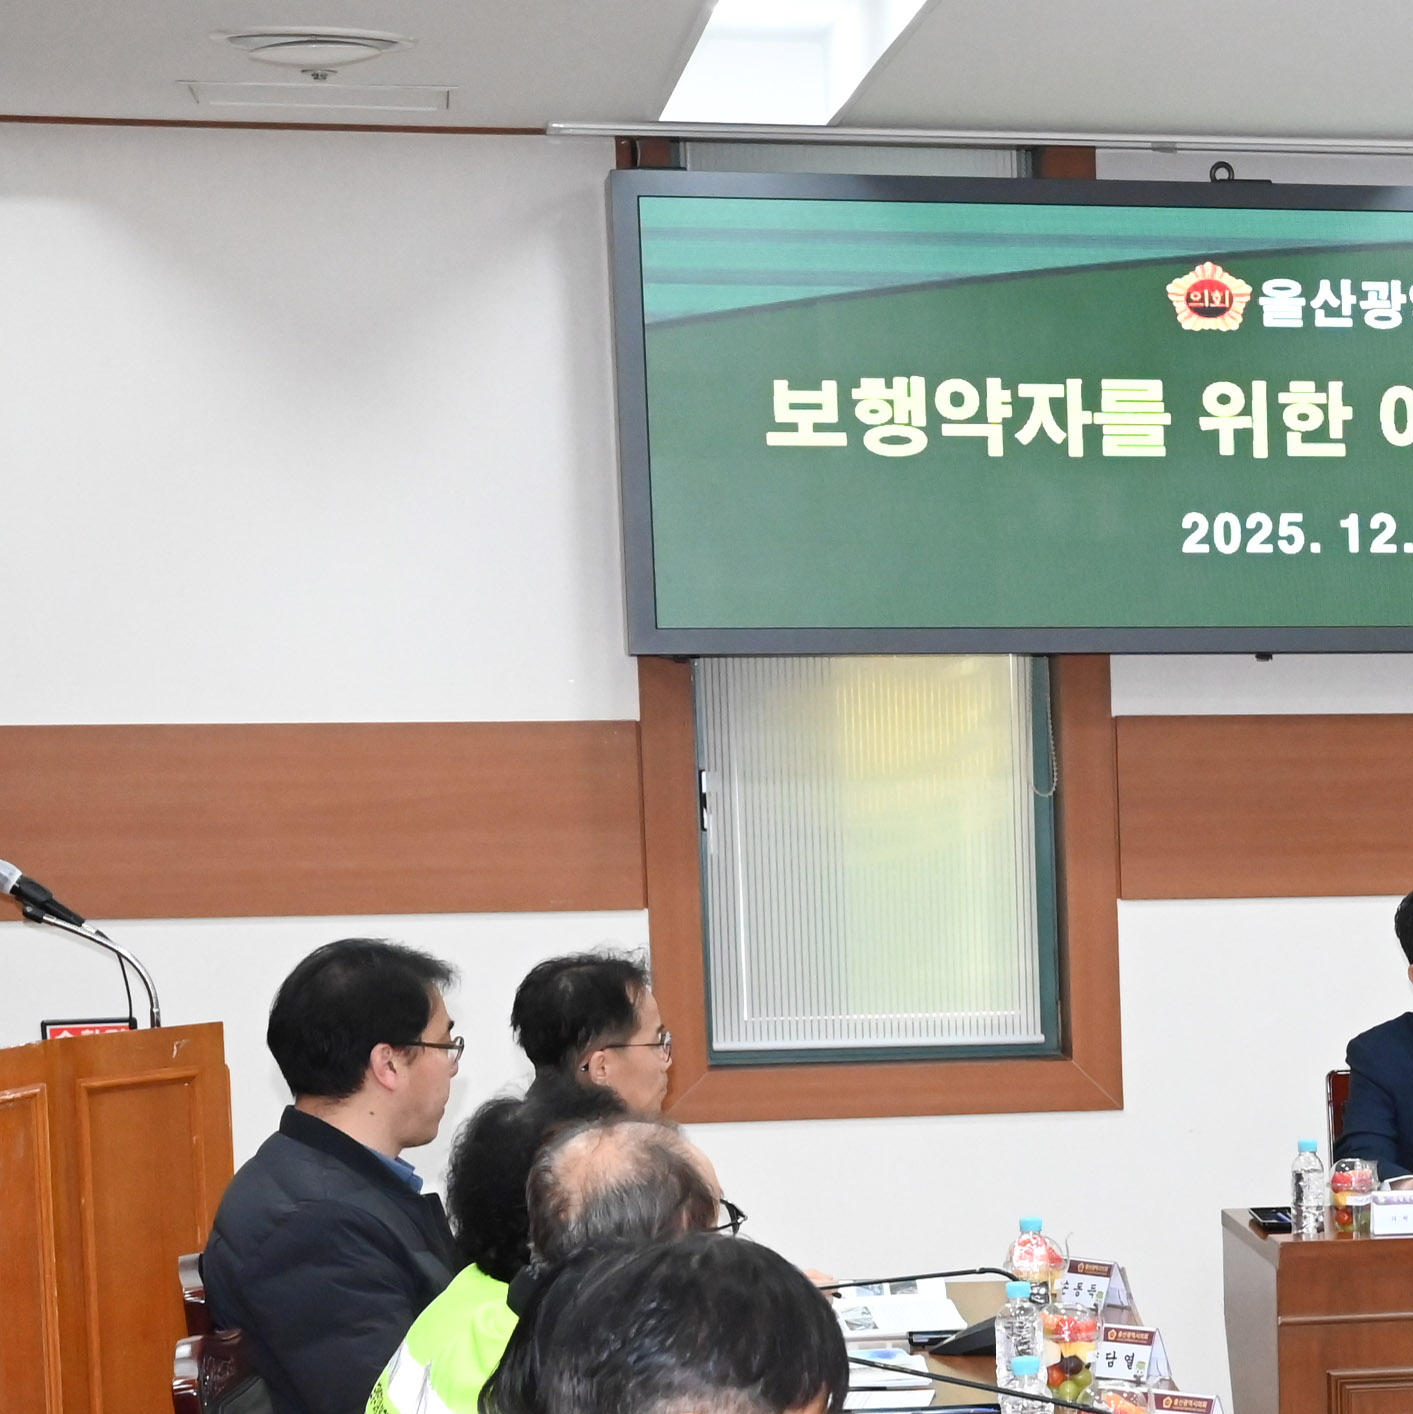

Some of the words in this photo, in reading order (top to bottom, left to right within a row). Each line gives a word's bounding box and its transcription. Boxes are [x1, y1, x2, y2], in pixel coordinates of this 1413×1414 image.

[1188, 289, 1230, 308] 의회
[765, 375, 1172, 458] 보행약자를
[1198, 380, 1353, 459] 위한
[1181, 511, 1321, 555] 2025.
[1339, 512, 1413, 554] 12.
